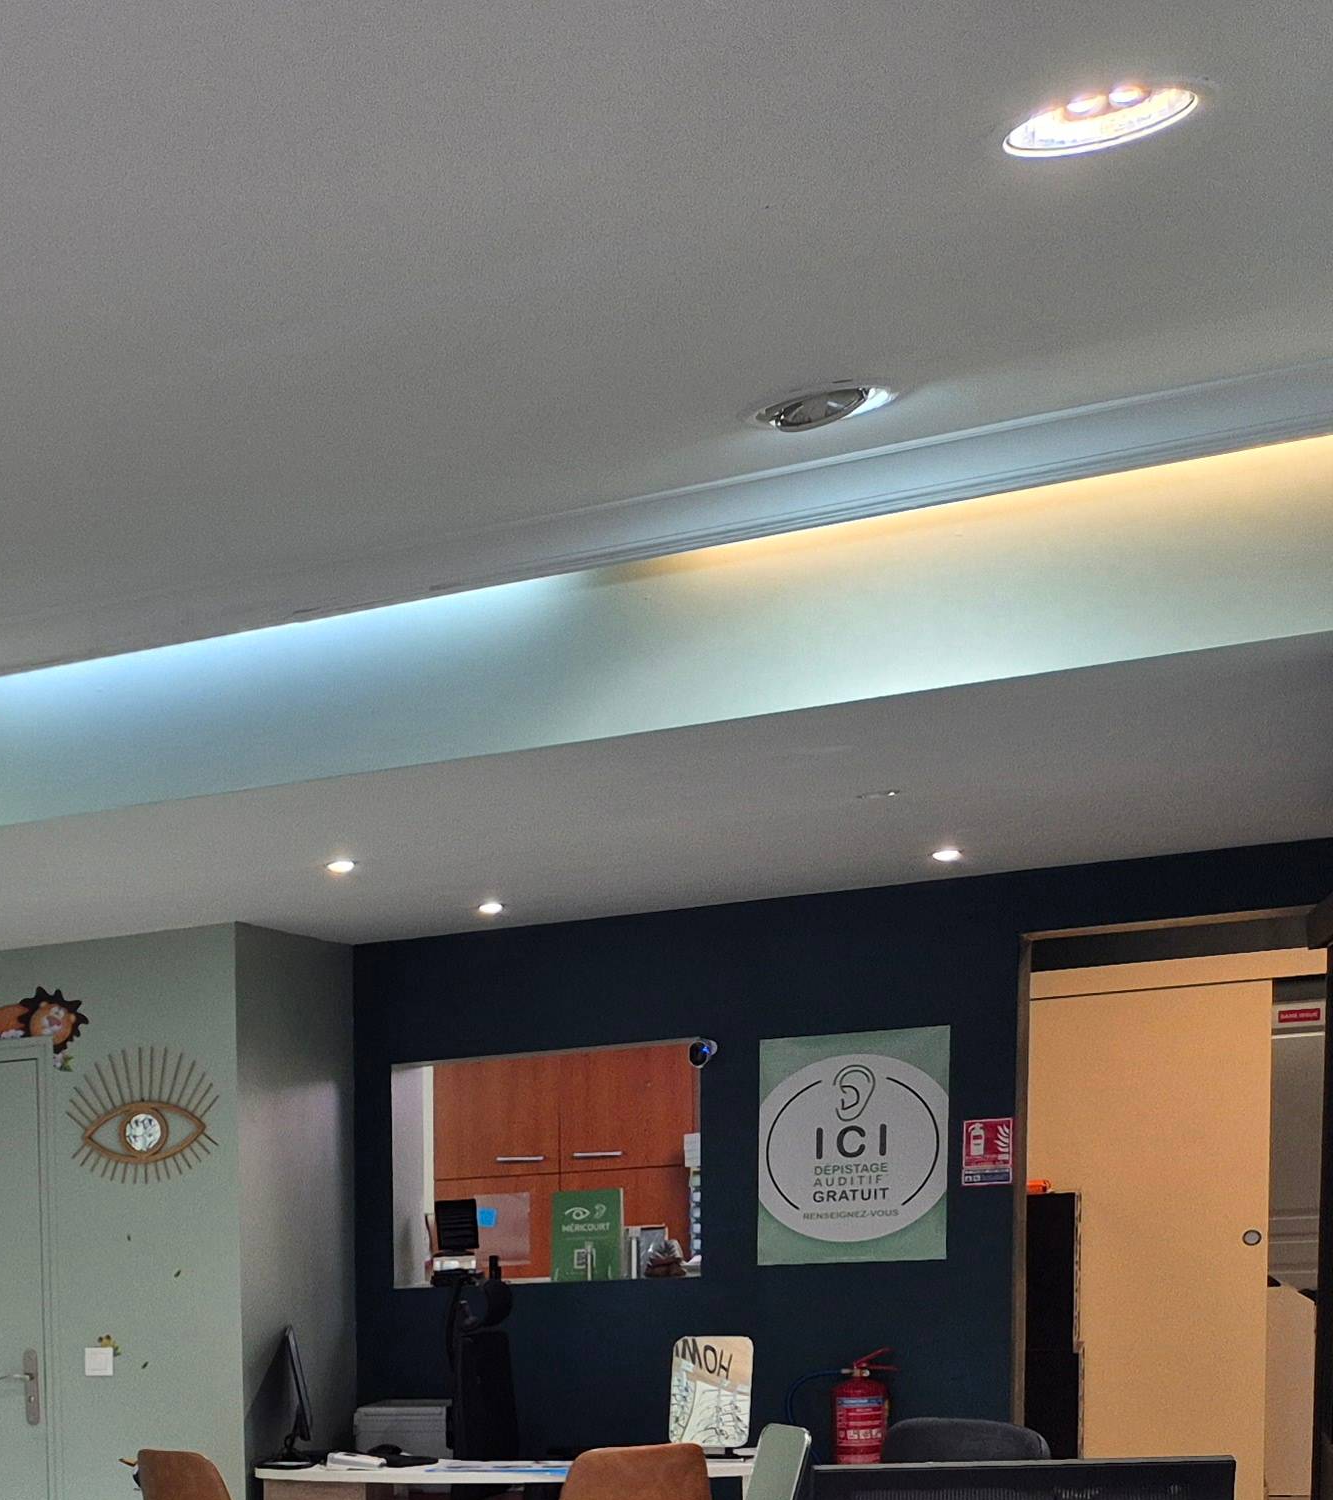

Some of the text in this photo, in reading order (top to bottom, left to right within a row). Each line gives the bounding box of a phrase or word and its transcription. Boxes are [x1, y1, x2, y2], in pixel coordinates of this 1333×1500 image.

[815, 1123, 888, 1160] ICI
[813, 1174, 884, 1187] AUDITIF
[812, 1187, 890, 1203] GRATUIT
[802, 1208, 899, 1220] RENSEIGNEZ-VOUS
